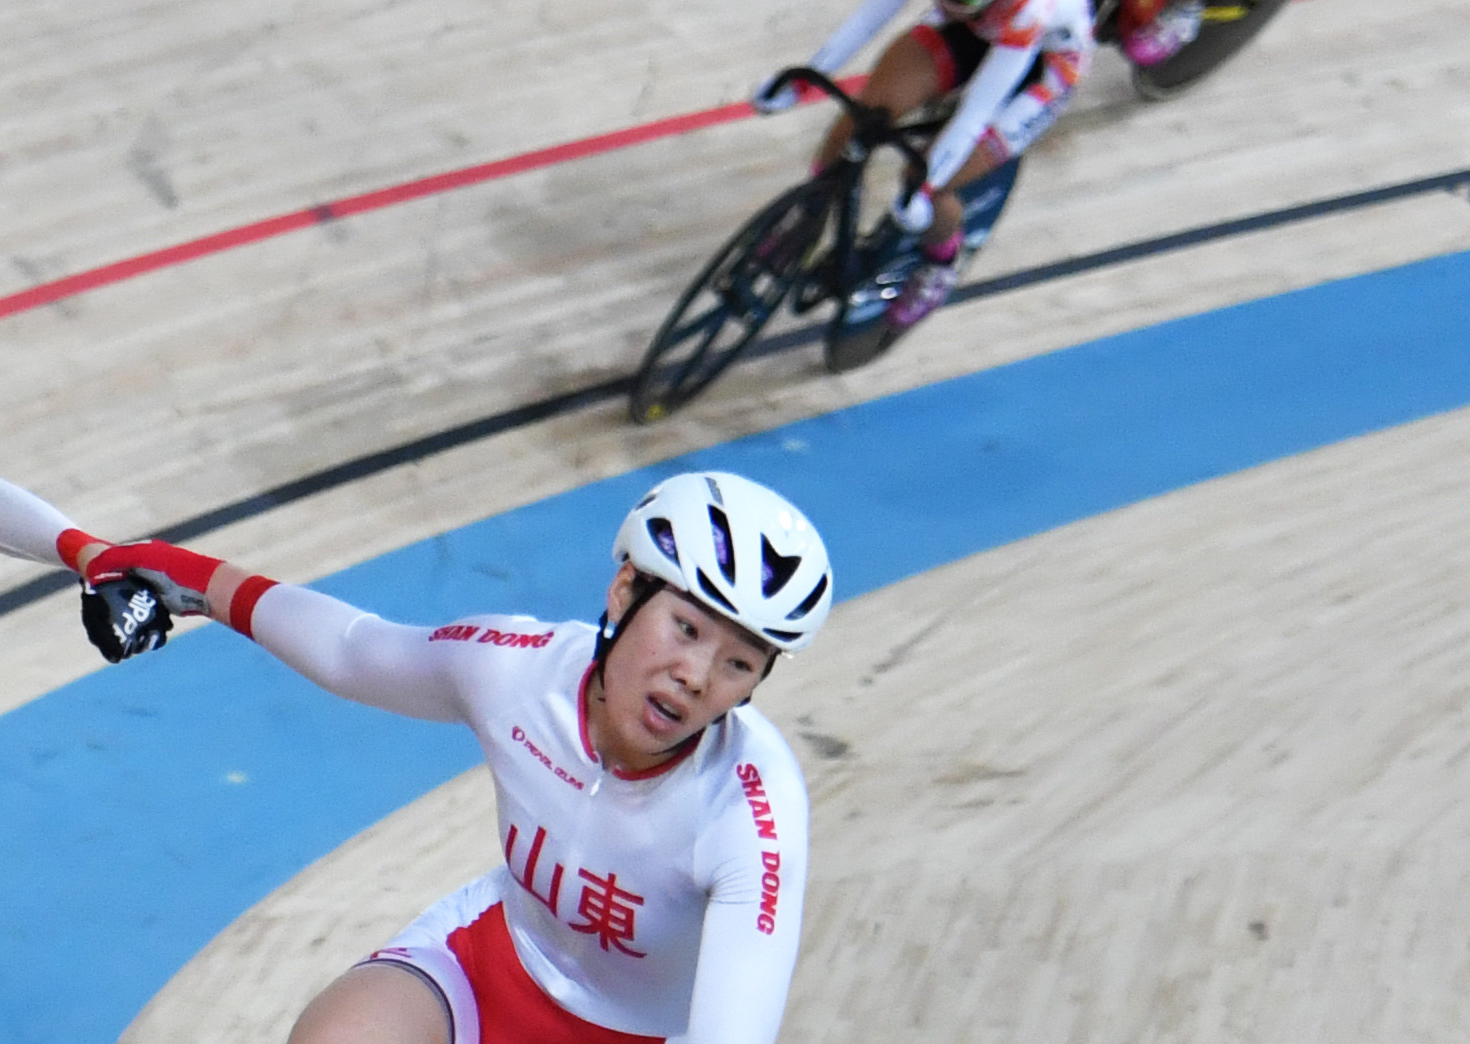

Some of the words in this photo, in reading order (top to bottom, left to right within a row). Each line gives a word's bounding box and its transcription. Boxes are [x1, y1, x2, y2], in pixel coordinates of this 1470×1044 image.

[477, 628, 555, 649] DONG
[736, 763, 778, 841] SHAN
[504, 823, 648, 959] 山東
[756, 850, 780, 936] DONG
